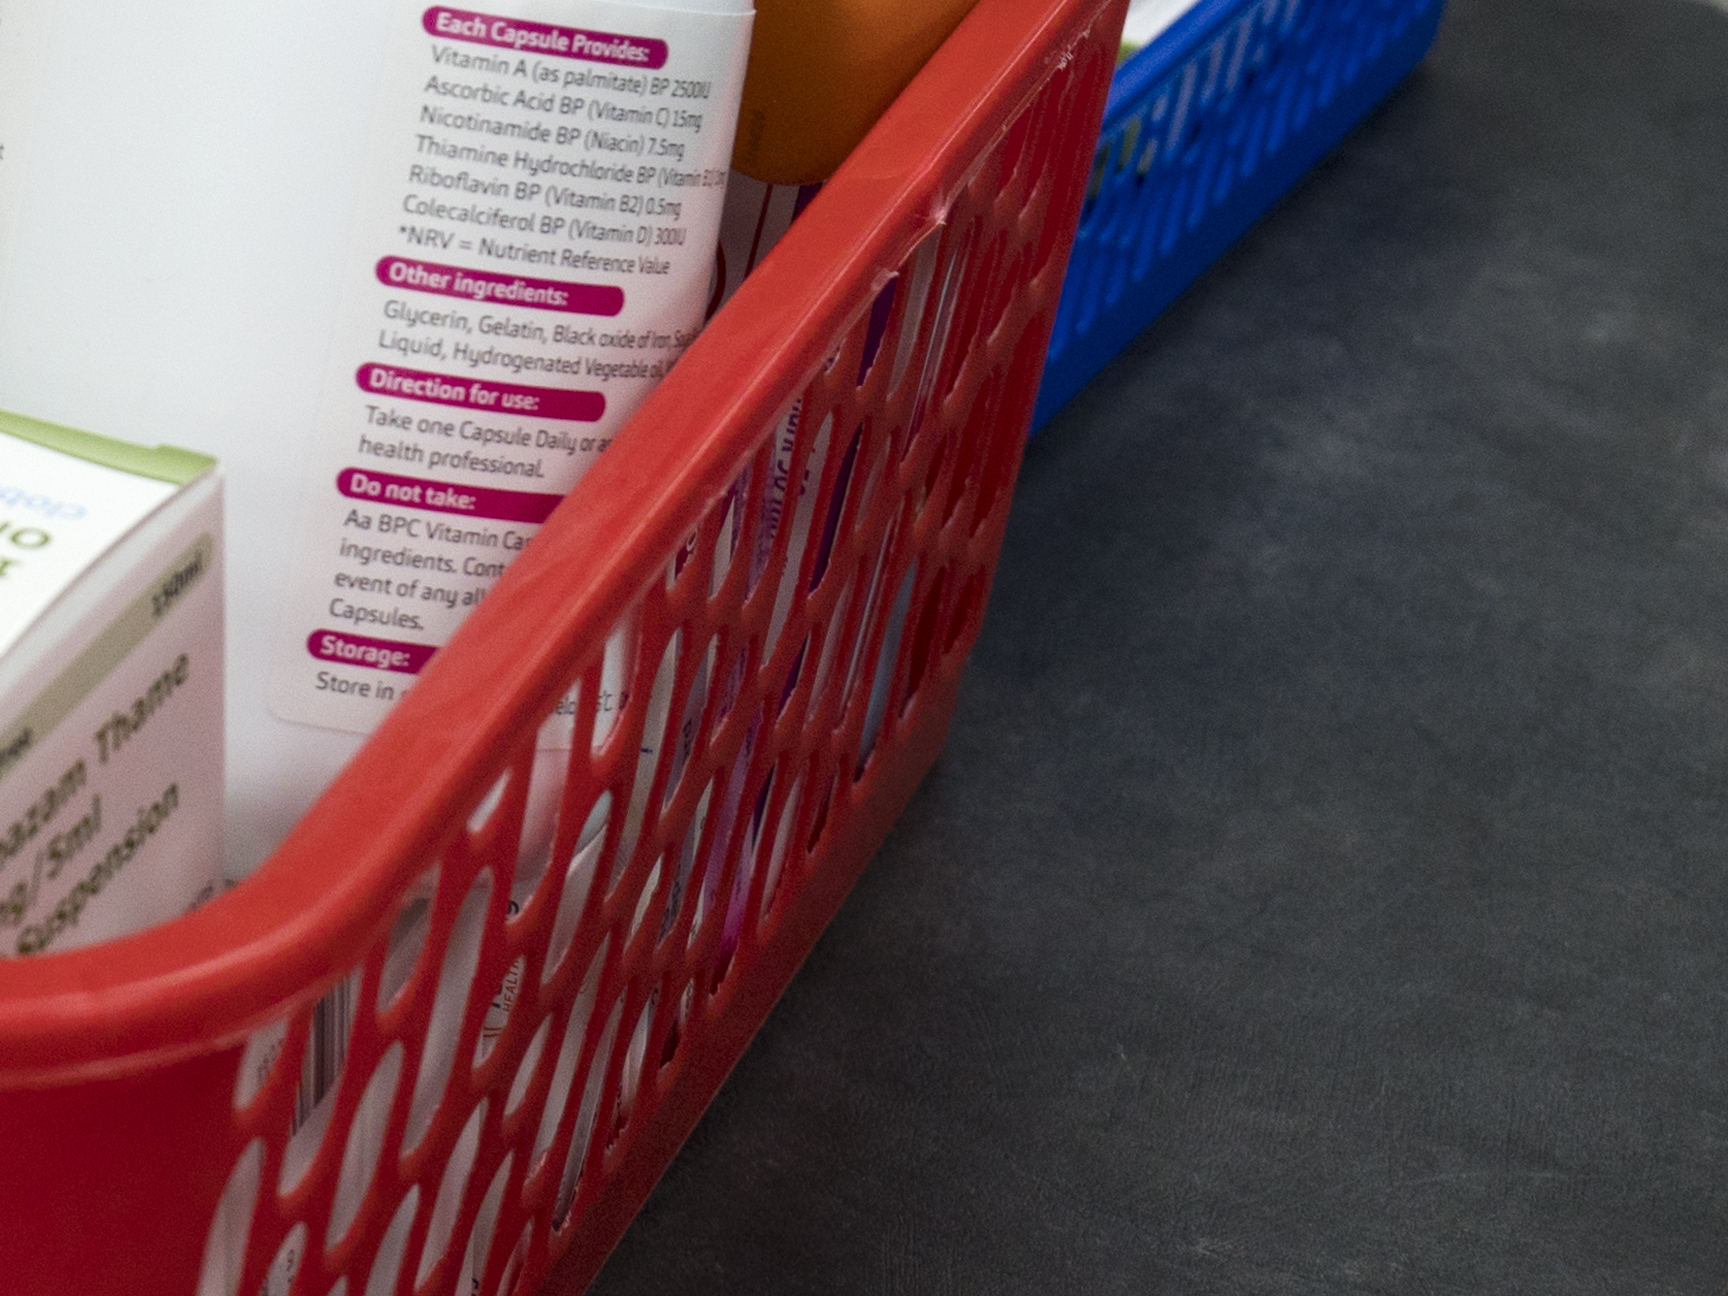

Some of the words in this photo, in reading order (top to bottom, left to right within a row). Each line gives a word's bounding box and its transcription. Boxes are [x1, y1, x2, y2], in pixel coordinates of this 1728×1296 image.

[434, 9, 488, 39] Each
[488, 18, 571, 53] Capsule
[569, 31, 651, 63] Provides:
[418, 103, 553, 145] Nicotinamide
[553, 123, 583, 147] BP
[582, 128, 647, 158] (Niacin)
[646, 135, 687, 164] 7.5mg
[387, 259, 453, 290] Other
[453, 272, 571, 307] ingredients:
[367, 365, 467, 402] Direction
[467, 381, 501, 406] for
[499, 391, 541, 412] use:
[348, 471, 383, 498] Do
[383, 482, 424, 504] not
[423, 485, 477, 511] take:
[318, 633, 411, 671] Storage:
